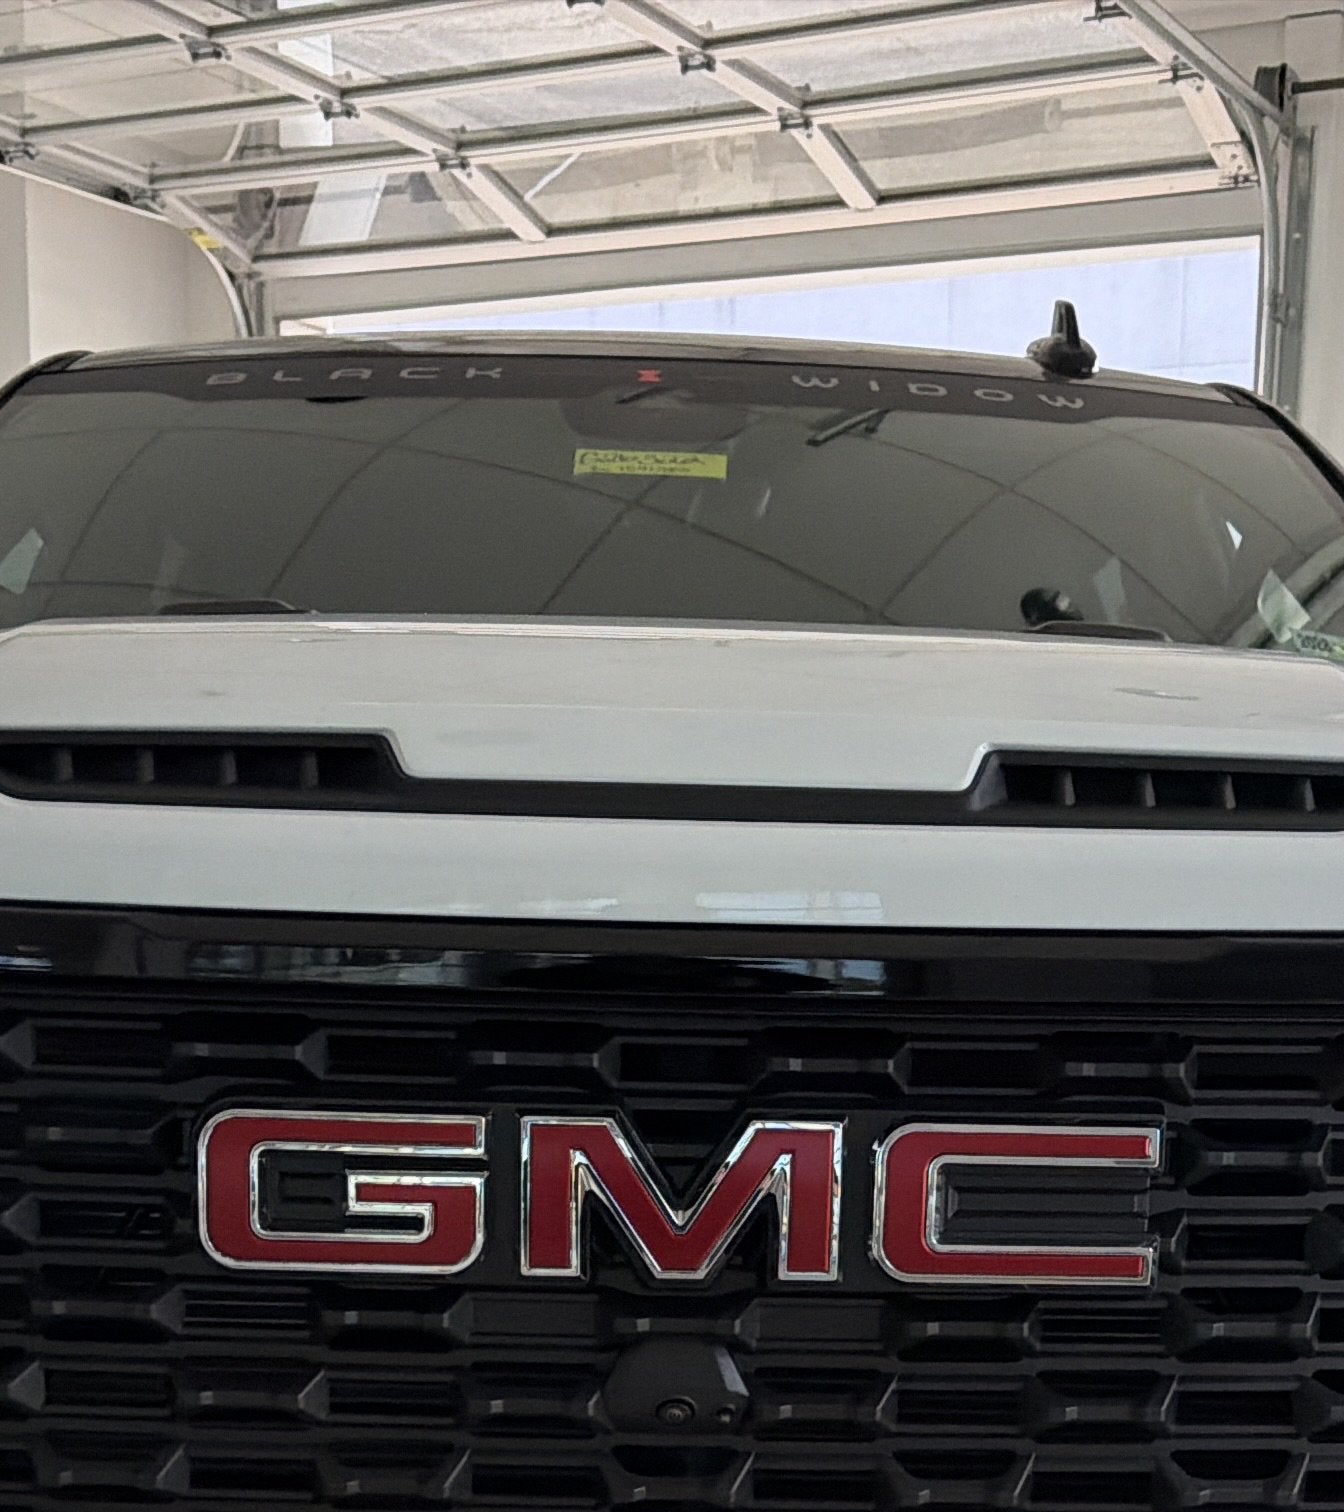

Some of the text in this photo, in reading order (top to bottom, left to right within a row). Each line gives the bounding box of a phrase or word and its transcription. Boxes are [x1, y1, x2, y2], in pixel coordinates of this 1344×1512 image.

[205, 365, 1086, 410] BLACK WIDOW
[196, 1107, 1166, 1287] GMC
